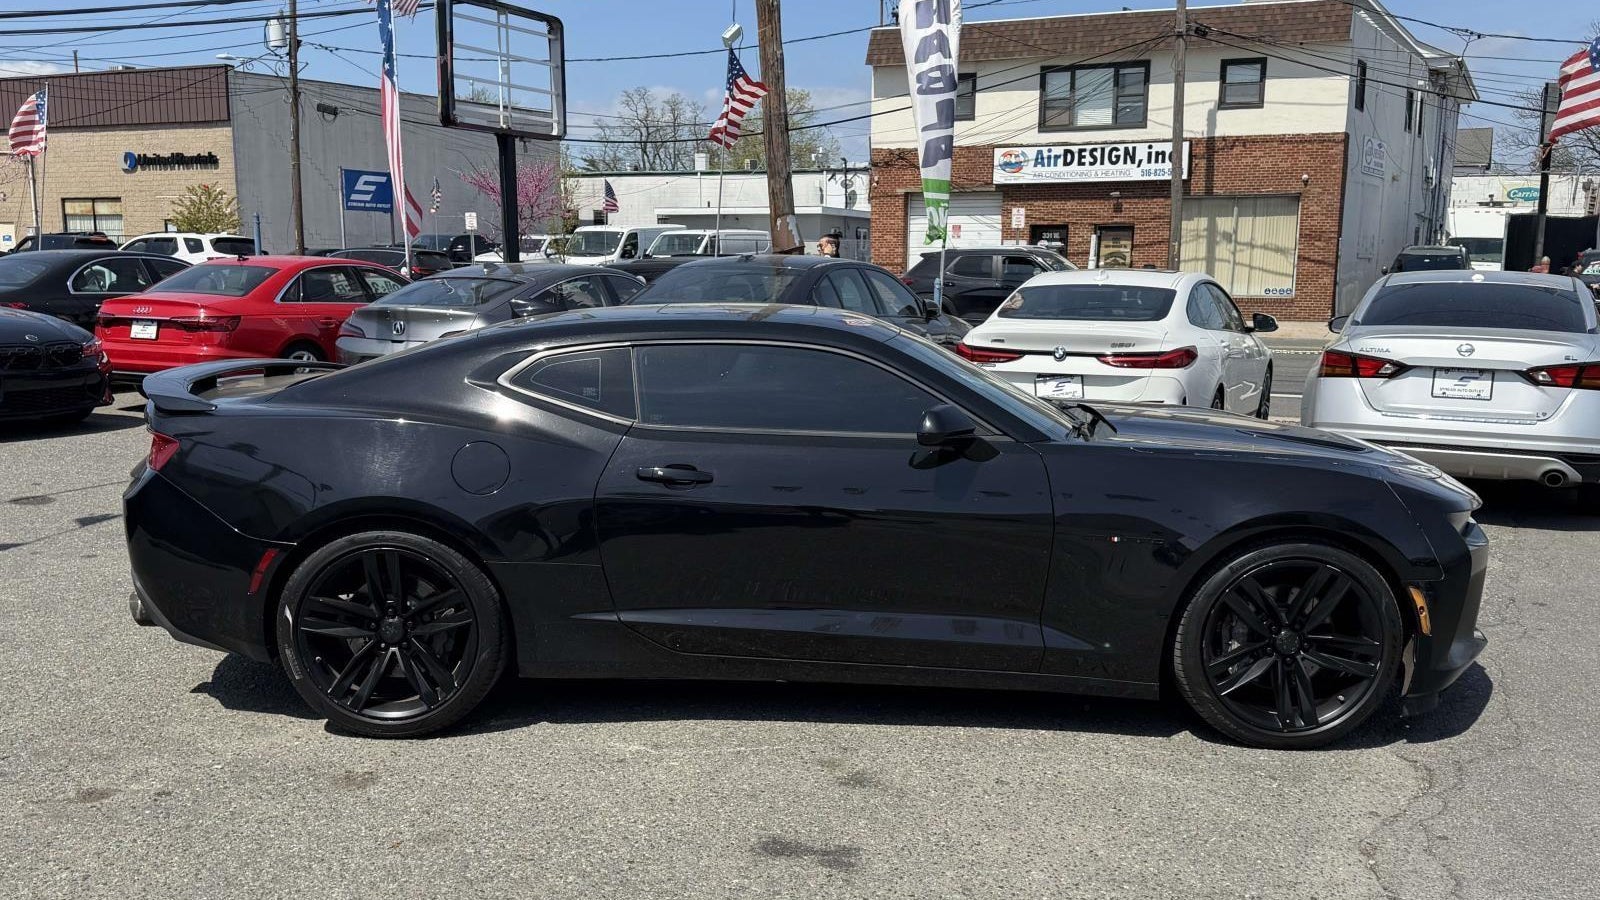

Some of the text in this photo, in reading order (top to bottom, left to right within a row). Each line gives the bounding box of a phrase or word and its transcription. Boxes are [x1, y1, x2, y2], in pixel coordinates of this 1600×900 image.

[1033, 147, 1143, 168] AirDESIGN,
[1043, 170, 1092, 179] CONDITIONING
[1101, 169, 1131, 177] HEATING
[1510, 189, 1540, 199] Carrie
